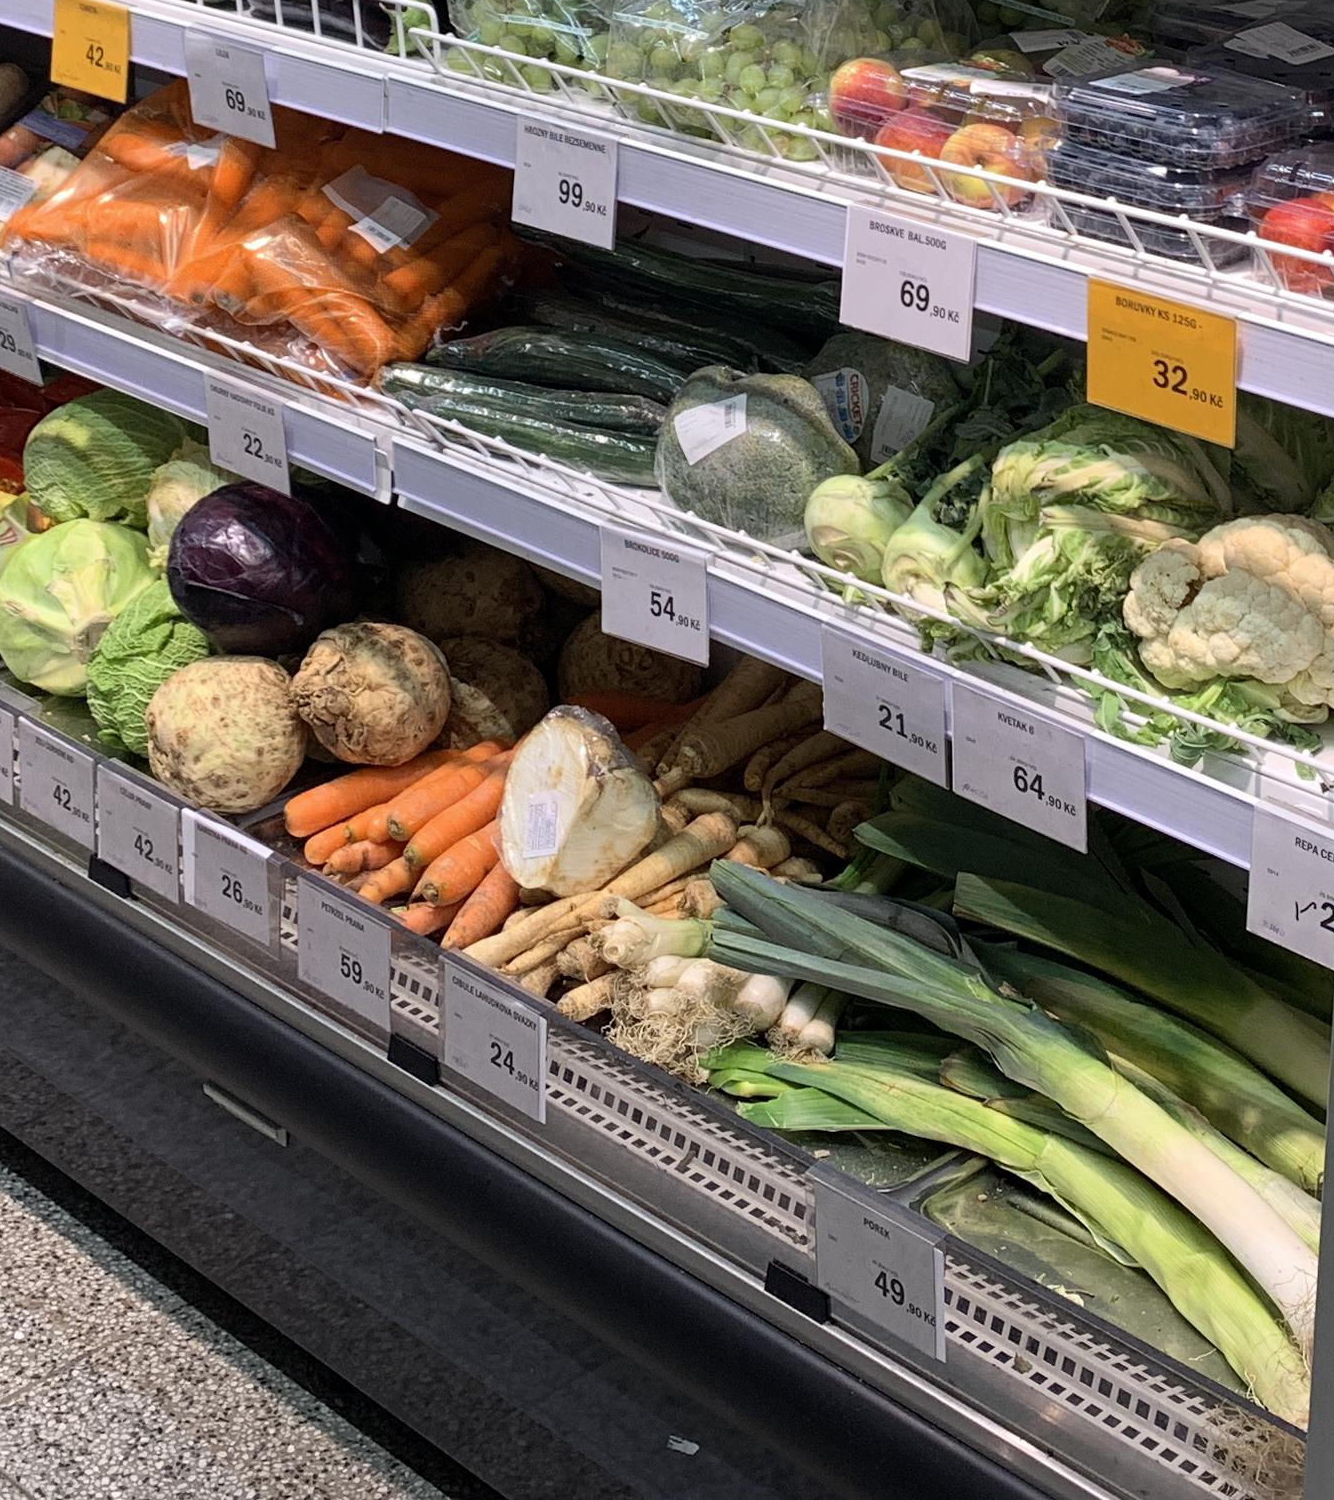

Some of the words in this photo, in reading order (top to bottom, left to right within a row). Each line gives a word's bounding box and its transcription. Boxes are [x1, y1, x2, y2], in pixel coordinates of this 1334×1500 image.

[558, 178, 595, 213] 99,90
[596, 203, 607, 217] Kč
[868, 220, 905, 239] BROSKVE
[898, 279, 946, 320] 69,90
[947, 308, 960, 324] Kč
[1114, 295, 1155, 317] BORUVKY
[1156, 307, 1170, 322] KS
[1172, 312, 1197, 330] 125G
[1151, 358, 1207, 403] 32,90
[1208, 390, 1224, 409] Kč
[623, 538, 660, 560] BROKOLICE
[649, 590, 690, 628] 54,90
[690, 616, 701, 632] Kč
[852, 649, 891, 676] KEDLUBNY
[892, 666, 908, 684] BILE
[878, 704, 924, 747] 21,90
[925, 738, 938, 755] Kč
[997, 711, 1028, 733] KVETAK
[1012, 765, 1062, 809] 64,90
[1063, 799, 1076, 818] Kč
[1294, 837, 1317, 858] REPA
[343, 913, 365, 933] PRANA
[339, 951, 374, 995] 59,90
[374, 984, 385, 1000] Kč
[451, 975, 474, 998] CIBULE
[489, 1040, 527, 1084] 24,90
[528, 1077, 539, 1092] Kč
[863, 1216, 890, 1240] POREK
[874, 1269, 923, 1318] 49,90
[924, 1309, 937, 1328] Kč
